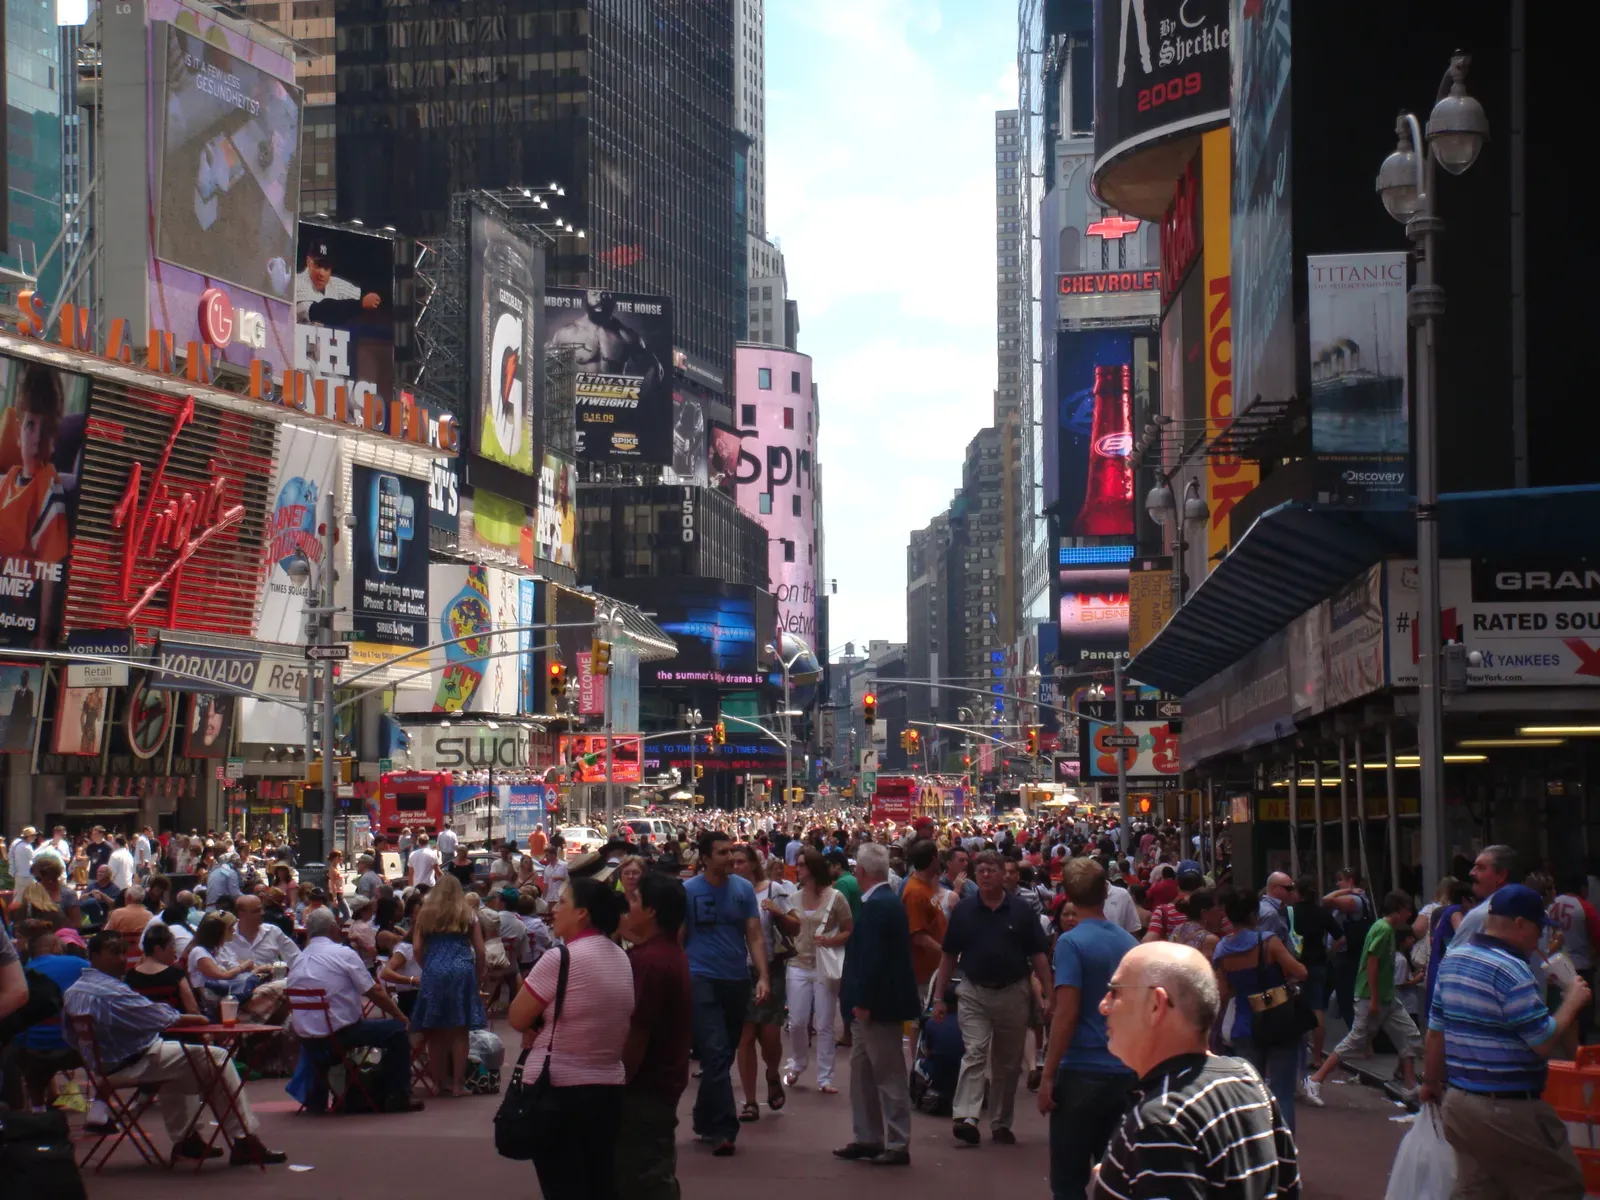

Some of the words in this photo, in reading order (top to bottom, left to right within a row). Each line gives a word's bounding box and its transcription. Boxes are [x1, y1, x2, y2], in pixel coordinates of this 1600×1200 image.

[1159, 19, 1176, 38] By
[196, 74, 260, 117] GESUNDHEITS?
[1137, 72, 1202, 113] 2009
[1060, 272, 1161, 294] CHEVROLET
[1313, 264, 1402, 283] TITANIC
[499, 287, 523, 314] GATORADE
[572, 298, 583, 309] IN
[616, 301, 632, 314] THE
[634, 303, 662, 316] HOUSE
[239, 310, 267, 349] LG
[250, 359, 460, 451] BUILDING
[583, 412, 614, 424] 9.16.09
[611, 436, 639, 445] SPIKE
[1346, 470, 1404, 484] Discovery
[682, 486, 694, 543] 1500
[3, 557, 32, 579] ALL
[34, 561, 63, 582] THE
[270, 583, 287, 594] TIMES
[288, 585, 309, 597] SQUARE
[365, 578, 379, 592] Now
[380, 581, 401, 598] playing
[402, 587, 410, 597] on
[410, 588, 425, 601] your
[1495, 571, 1600, 591] GRAN
[776, 583, 799, 602] on
[387, 599, 393, 611] &
[393, 600, 407, 613] iPod
[1473, 612, 1548, 631] RATED
[1555, 612, 1600, 631] SOU
[68, 644, 129, 655] VORNADO
[158, 652, 255, 685] VORNADO
[1498, 654, 1561, 667] YANKEES
[84, 666, 112, 677] Retail
[657, 671, 673, 680] the
[675, 671, 714, 681] summer's
[726, 674, 752, 684] drama
[755, 674, 763, 684] is
[581, 657, 593, 712] WELCOME
